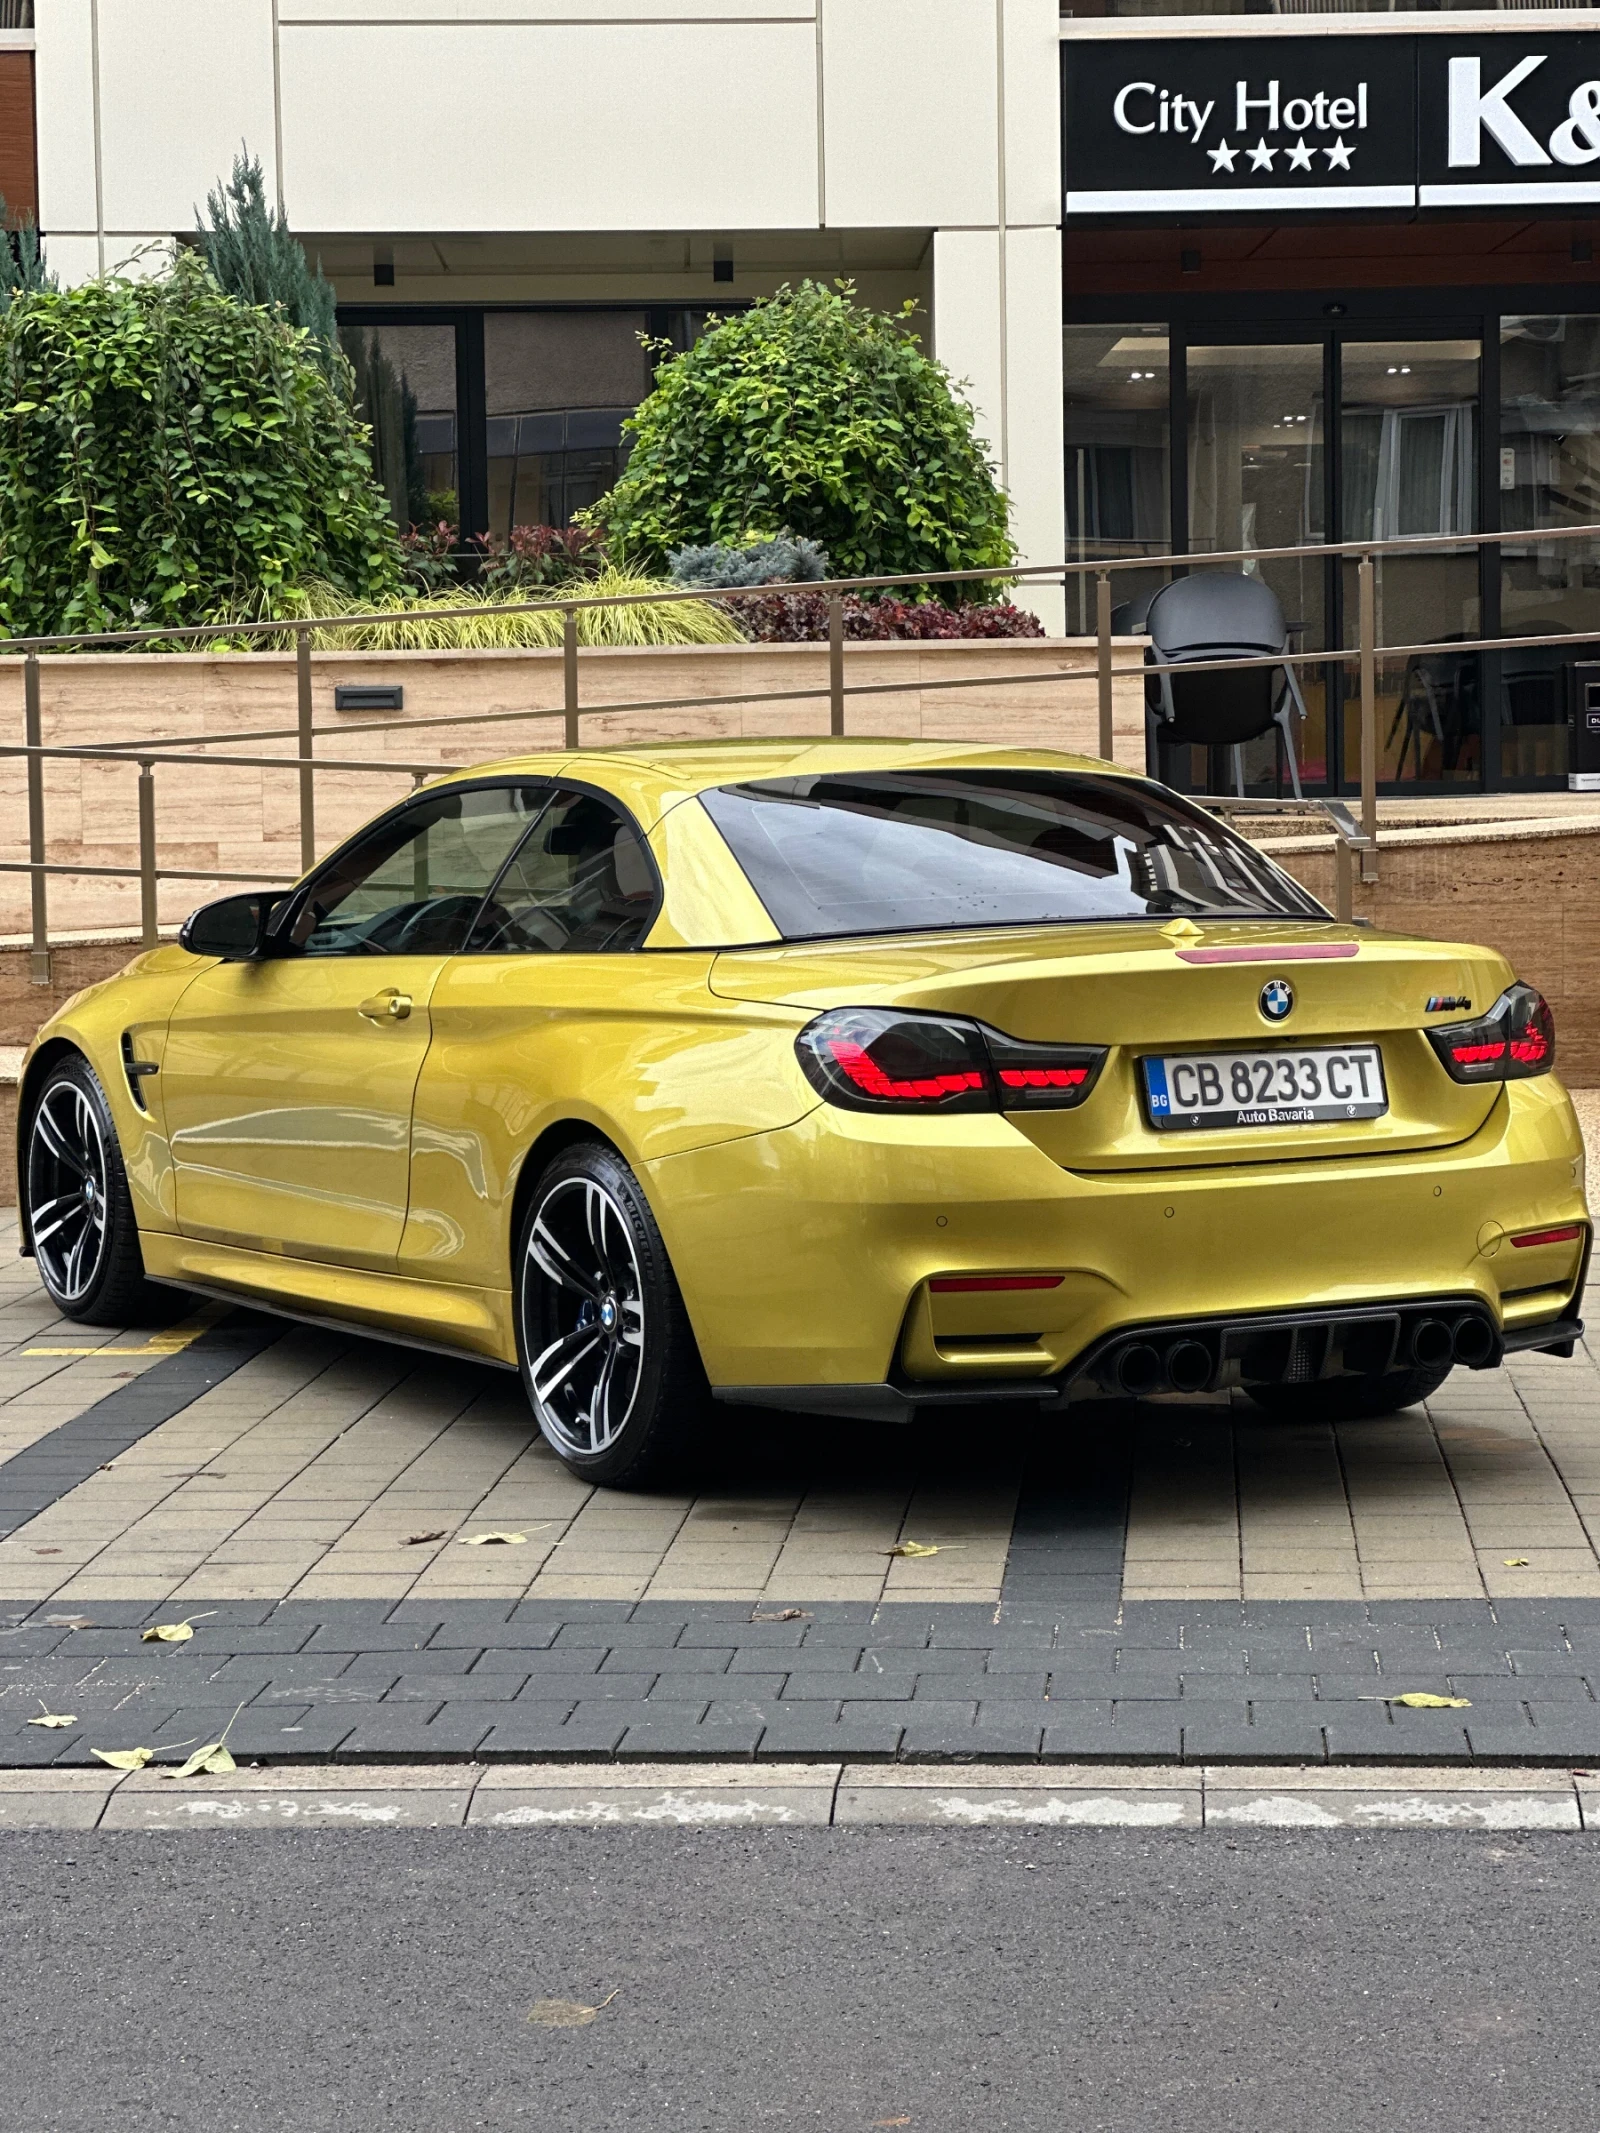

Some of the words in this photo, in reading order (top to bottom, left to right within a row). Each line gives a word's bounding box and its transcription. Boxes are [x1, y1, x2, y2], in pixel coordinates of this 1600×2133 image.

[1113, 80, 1215, 143] City
[1235, 80, 1368, 131] Hotel
[1172, 1062, 1224, 1107] CB
[1230, 1057, 1322, 1105] 8233
[1326, 1054, 1373, 1100] CT
[1152, 1095, 1168, 1108] BG
[1236, 1110, 1266, 1124] Auto
[1269, 1107, 1315, 1122] Bavaria
